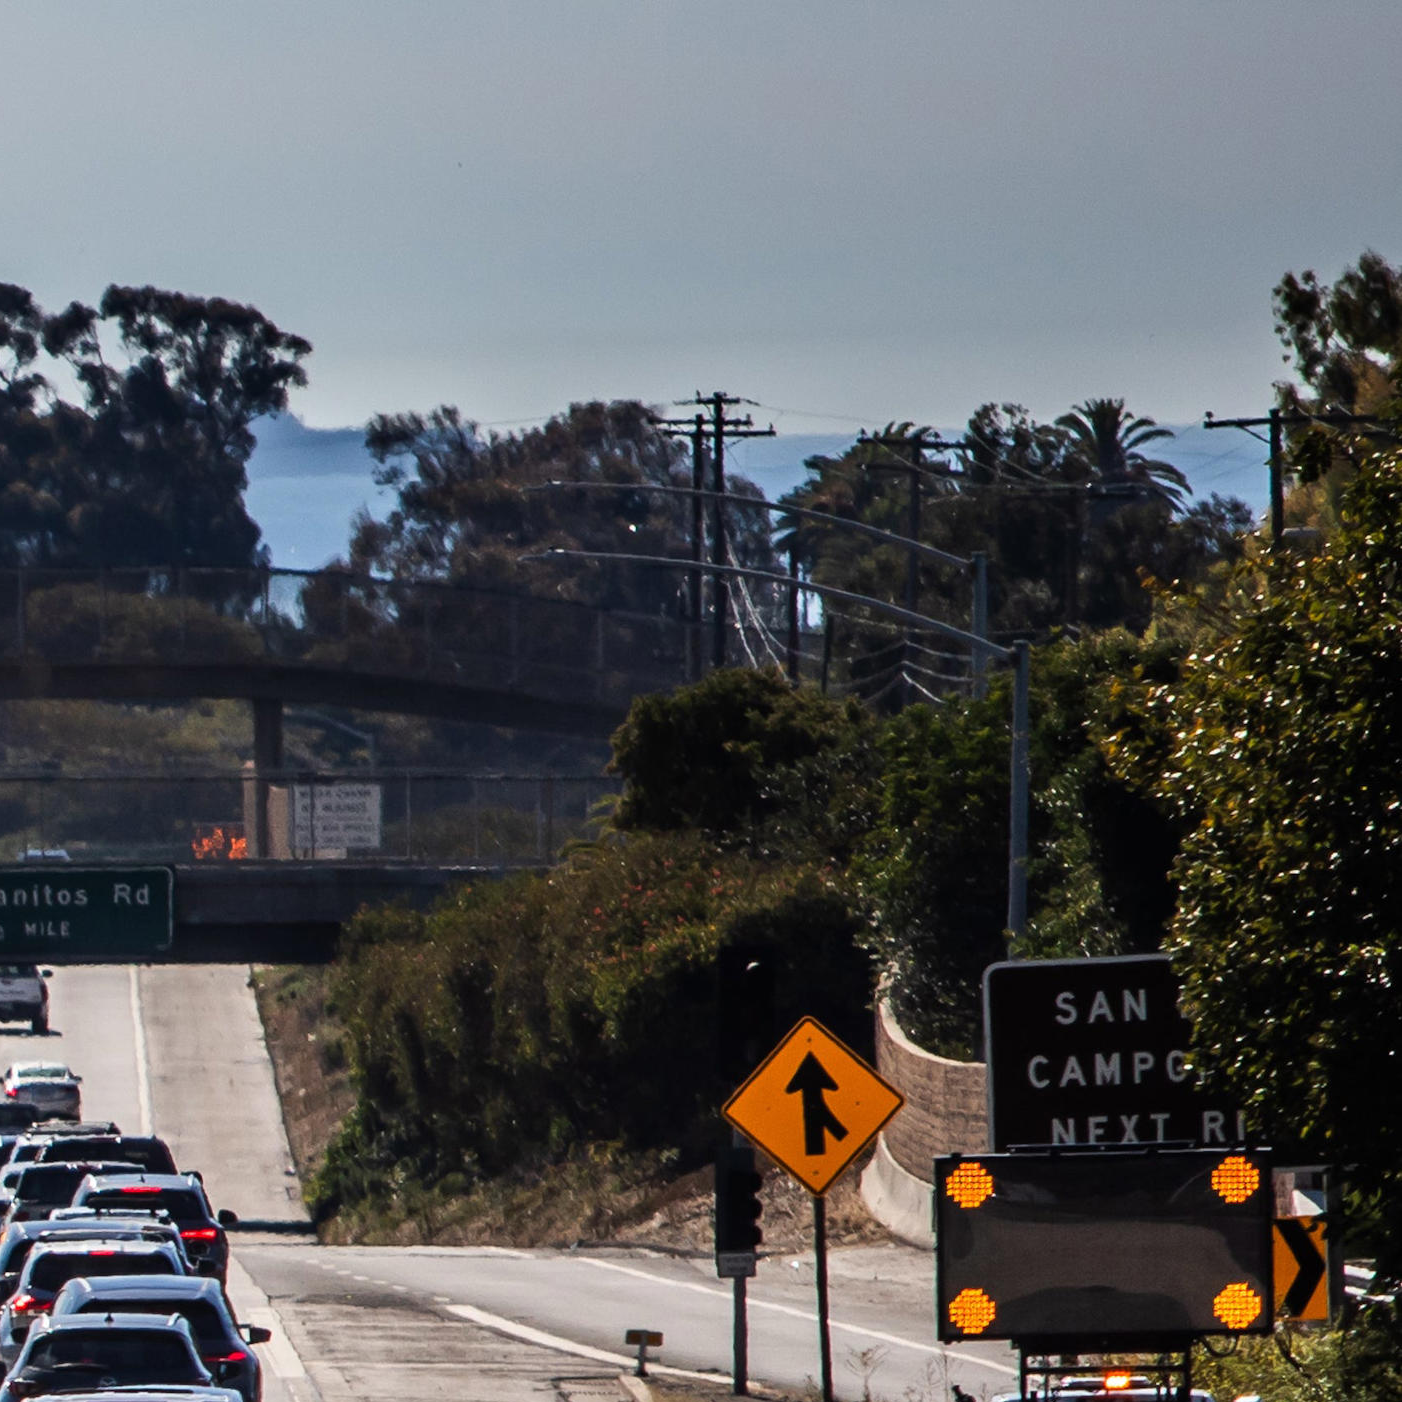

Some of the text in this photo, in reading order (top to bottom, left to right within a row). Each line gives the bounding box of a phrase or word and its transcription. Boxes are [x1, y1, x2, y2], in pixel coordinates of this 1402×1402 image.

[112, 883, 150, 906] Rd
[24, 920, 71, 937] MILE
[1054, 988, 1147, 1026] SAN
[1027, 1050, 1192, 1089] CAMPG
[1051, 1109, 1246, 1146] NEXT RI
